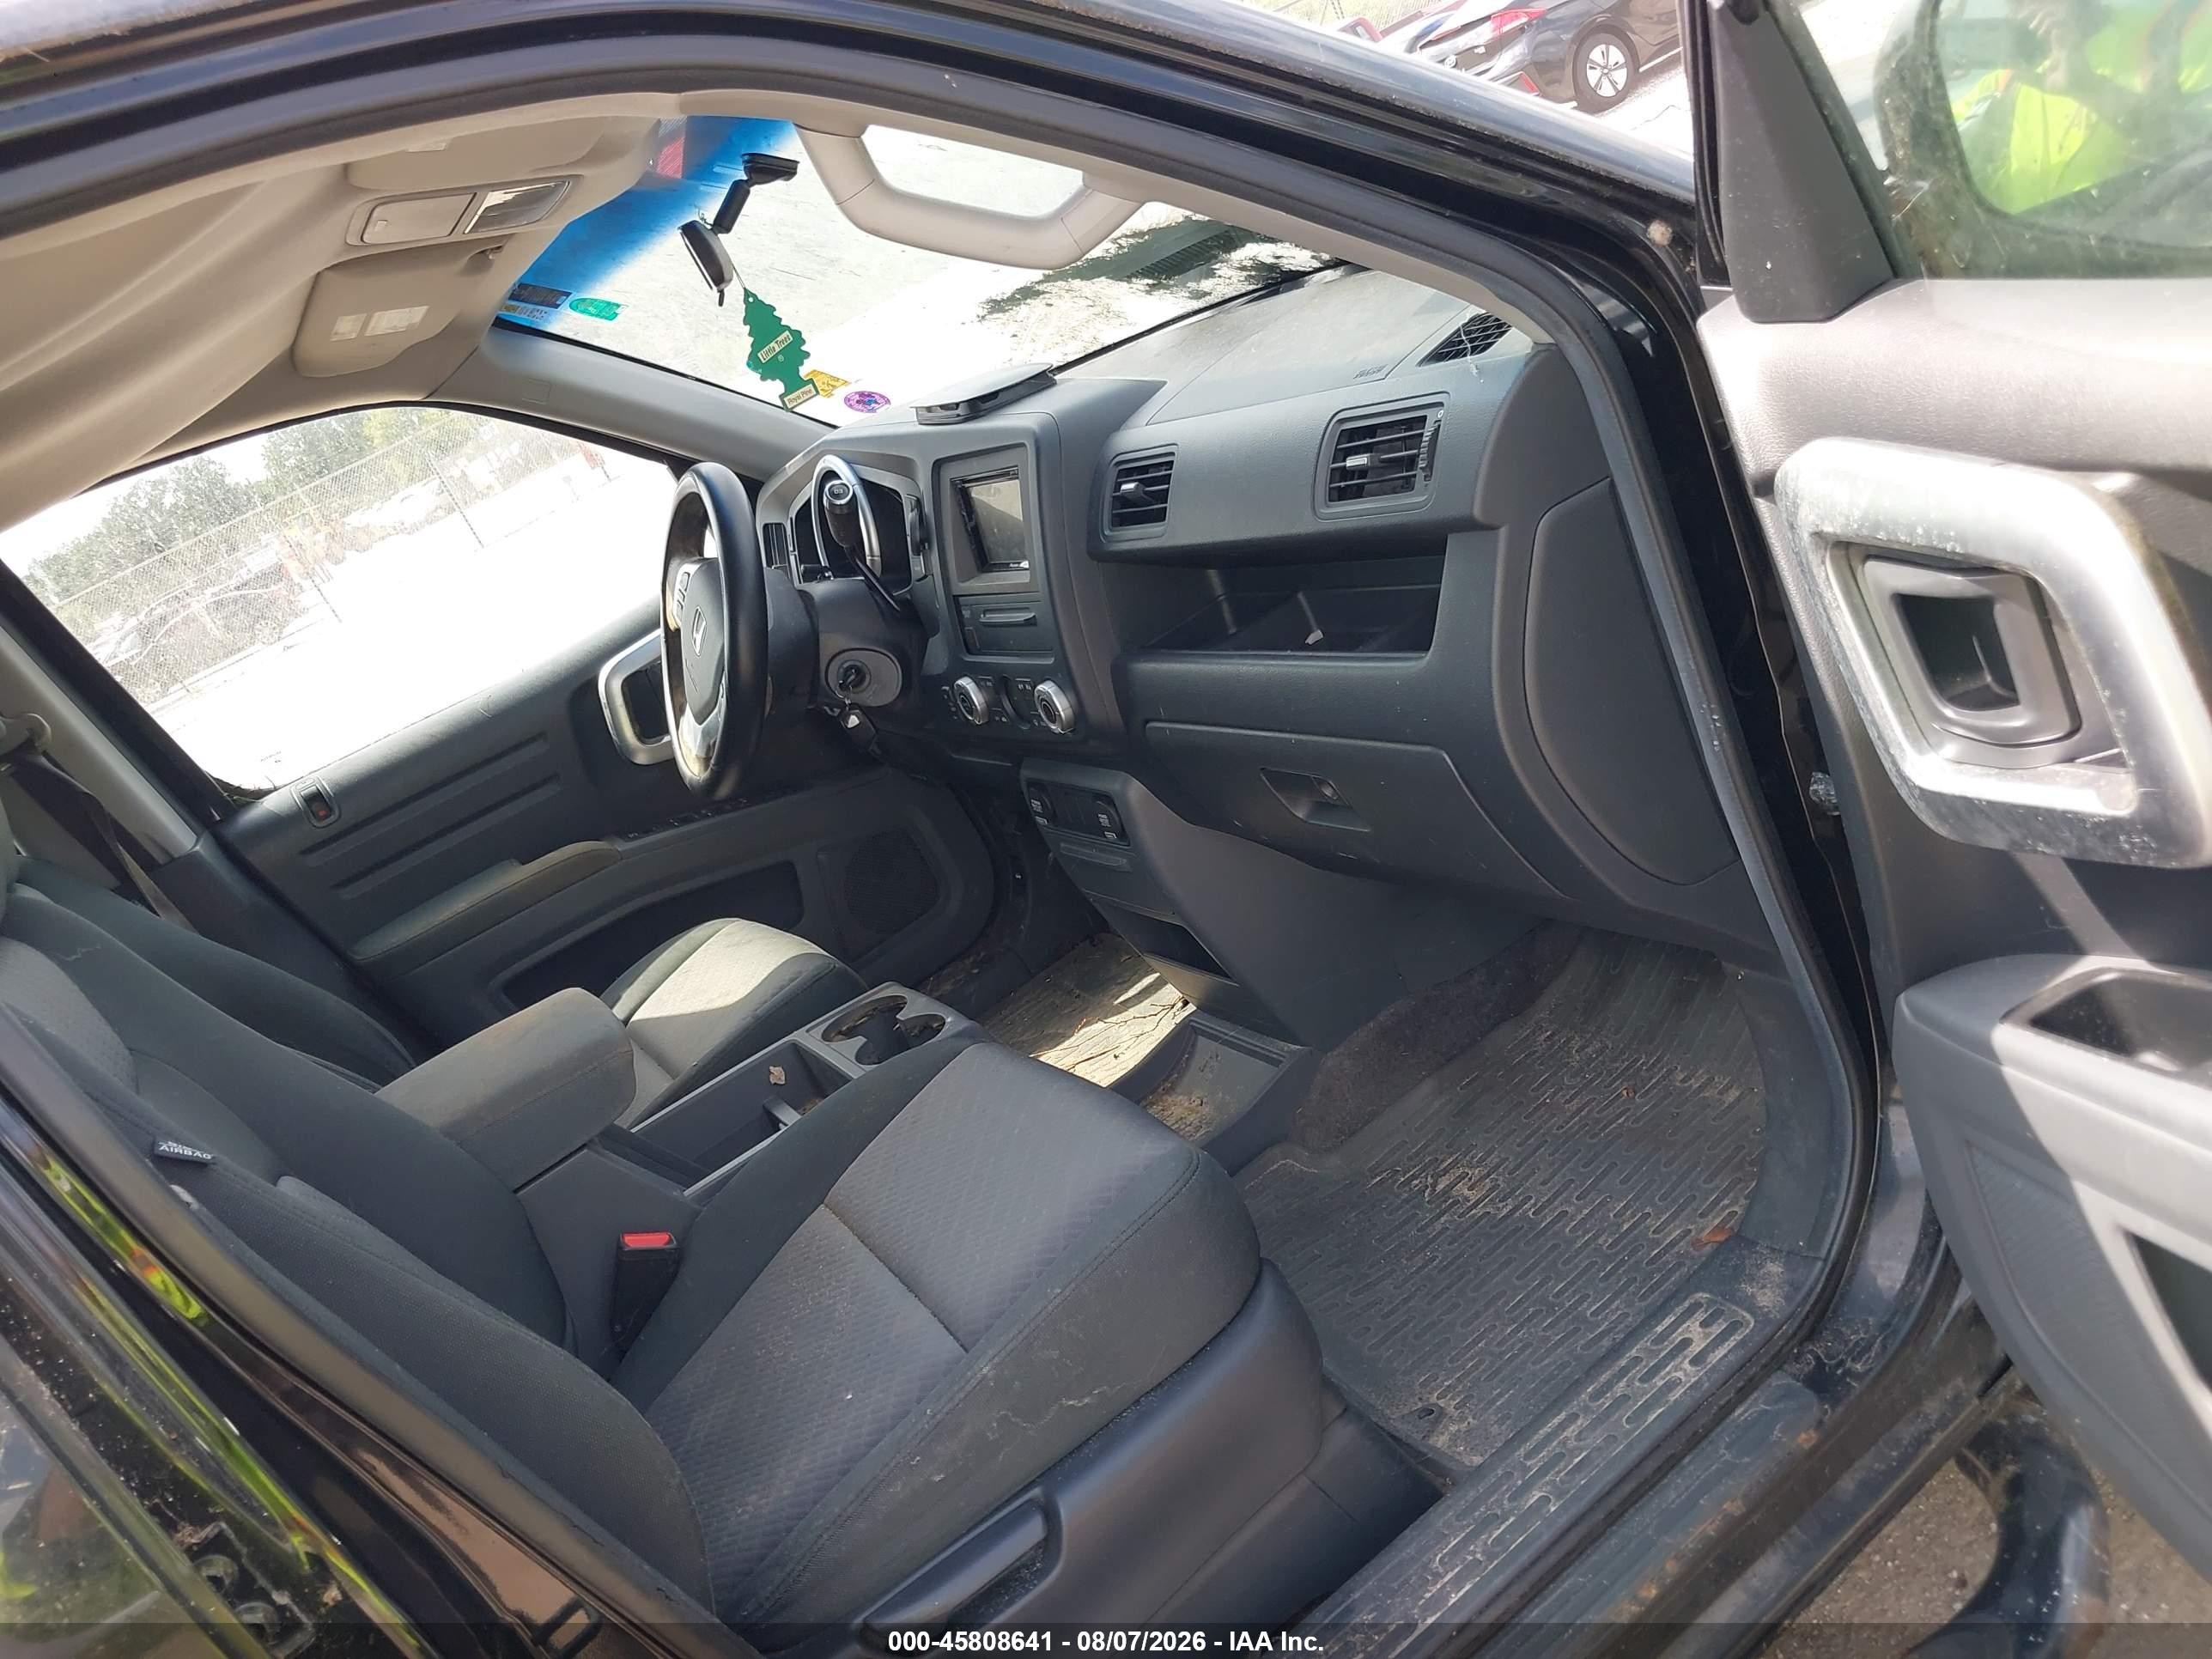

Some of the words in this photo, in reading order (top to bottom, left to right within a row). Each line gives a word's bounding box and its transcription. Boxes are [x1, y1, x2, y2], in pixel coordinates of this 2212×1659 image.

[760, 346, 776, 361] Little
[775, 335, 791, 349] Trees
[160, 1145, 213, 1159] AIRBAG
